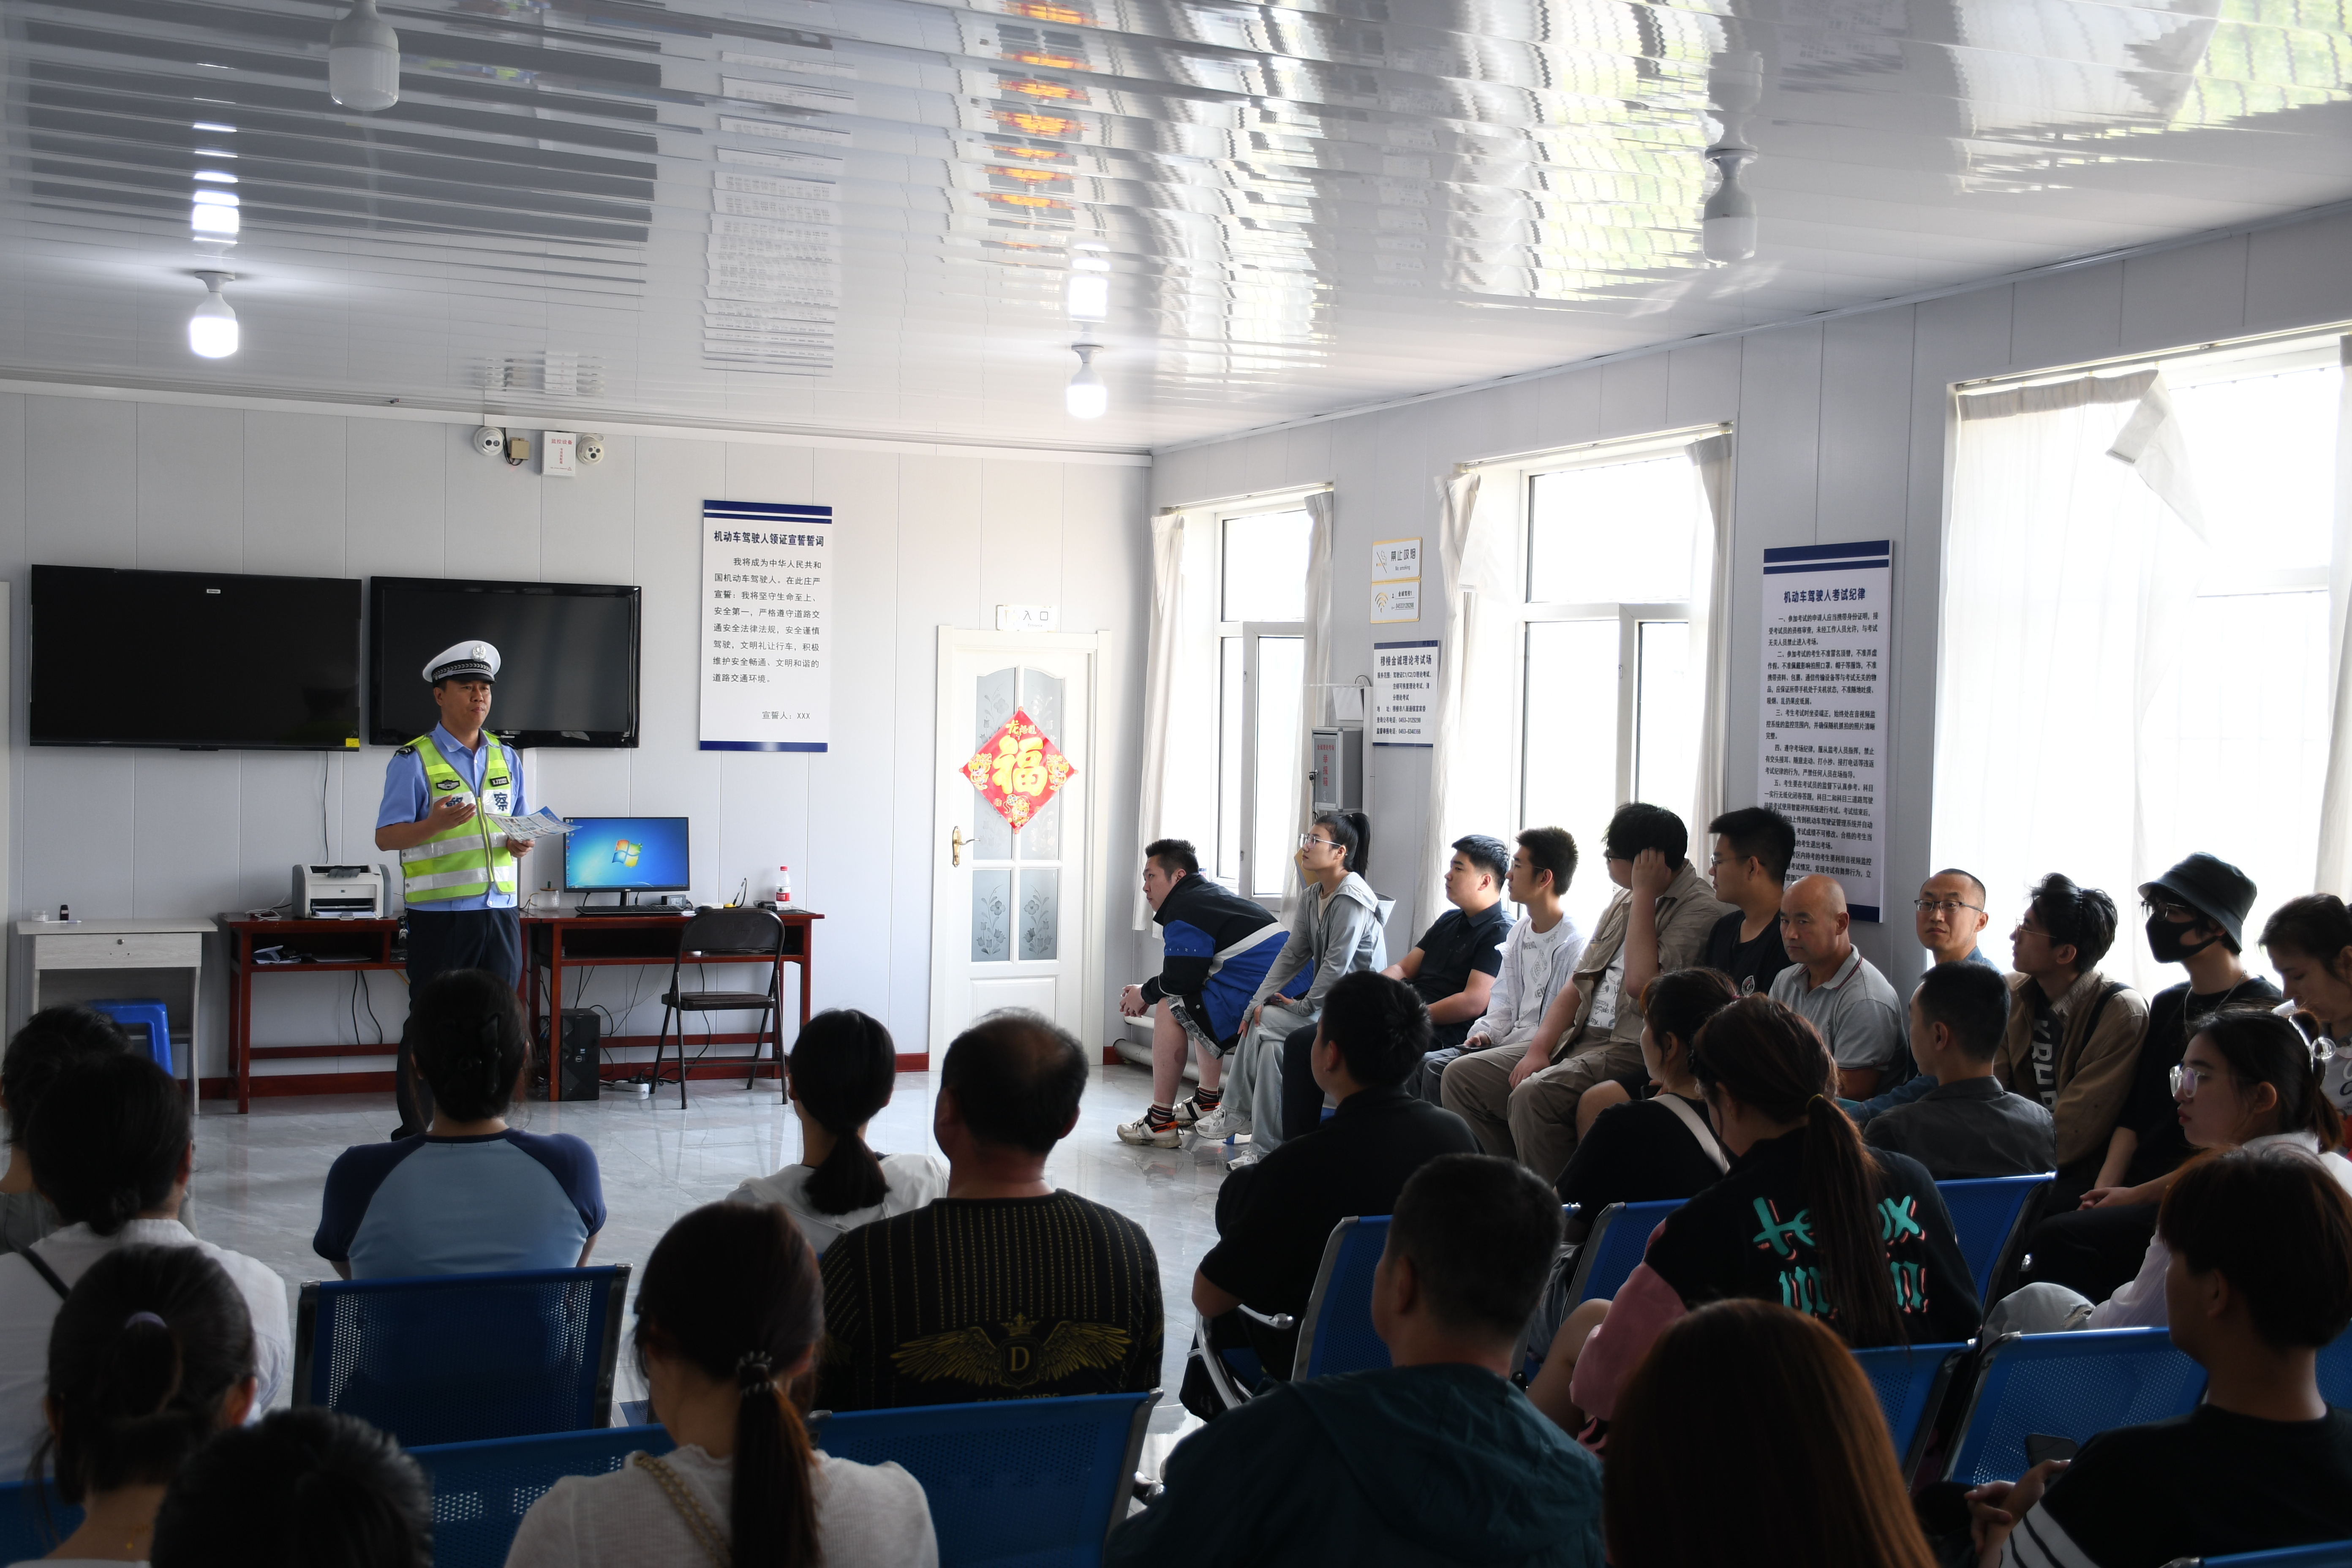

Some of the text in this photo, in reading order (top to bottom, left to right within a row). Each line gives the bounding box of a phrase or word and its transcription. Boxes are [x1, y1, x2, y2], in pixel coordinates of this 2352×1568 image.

[714, 531, 824, 547] 机动车驾驶人领证宣誓誓词
[1391, 548, 1416, 562] 禁止吸烟
[733, 558, 822, 569] 我将成为中华人民共和
[714, 573, 821, 586] 国机动车驾驶人。在此庄严
[714, 590, 816, 602] 宣誓：我将坚守生命至上、
[1783, 588, 1866, 603] 机动车驾驶人考试纪律
[714, 607, 820, 619] 安全第一，严格遵守道路交
[1023, 610, 1048, 621] 入口
[713, 623, 820, 635] 通安全法律法规，安全谨慎
[713, 640, 819, 651] 驾驶，文明礼让行车，积极
[1768, 638, 1818, 647] 无关人员禁止进入考场。
[713, 657, 819, 668] 维护安全畅通、文明和谐的
[1380, 654, 1432, 667] 穆棱金诚理论考试场
[713, 673, 770, 683] 道路交通环境。
[992, 735, 1048, 796] 福
[494, 792, 509, 811] 察
[1010, 1347, 1030, 1372] D
